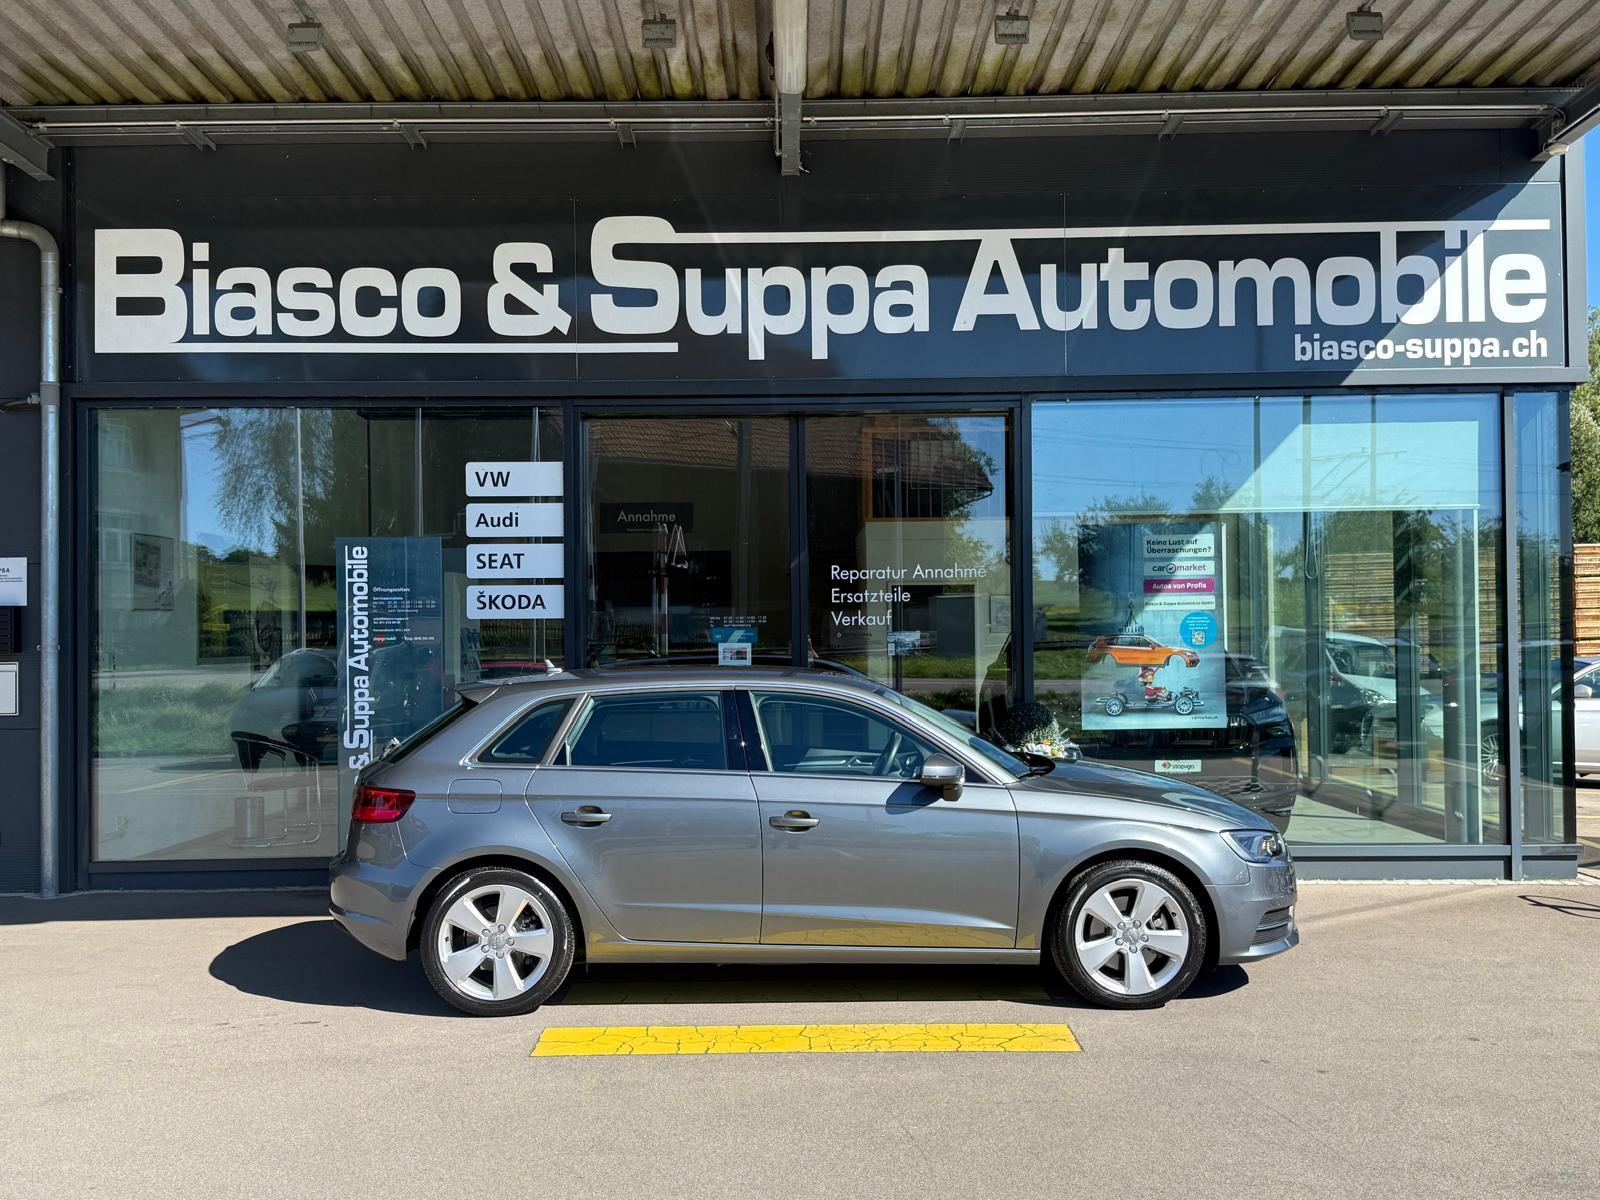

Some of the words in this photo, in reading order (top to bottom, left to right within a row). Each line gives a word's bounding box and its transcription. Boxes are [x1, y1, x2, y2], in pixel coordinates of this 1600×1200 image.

[94, 228, 462, 353] Biasco
[486, 242, 572, 336] &
[590, 216, 930, 361] Suppa
[953, 220, 1549, 333] Automobile
[1294, 329, 1548, 366] biasco-suppa.ch
[474, 471, 511, 488] VW
[475, 512, 519, 528] Audi
[616, 508, 677, 522] Annahme
[1146, 546, 1212, 554] Überraschungen?
[476, 553, 525, 570] SEAT
[831, 565, 907, 583] Reparatur
[912, 563, 987, 579] Annahme
[476, 591, 547, 610] ŠKODA
[831, 586, 911, 603] Ersatzteile
[345, 545, 369, 672] Automobile
[831, 610, 892, 626] Verkauf
[344, 675, 375, 749] Suppa
